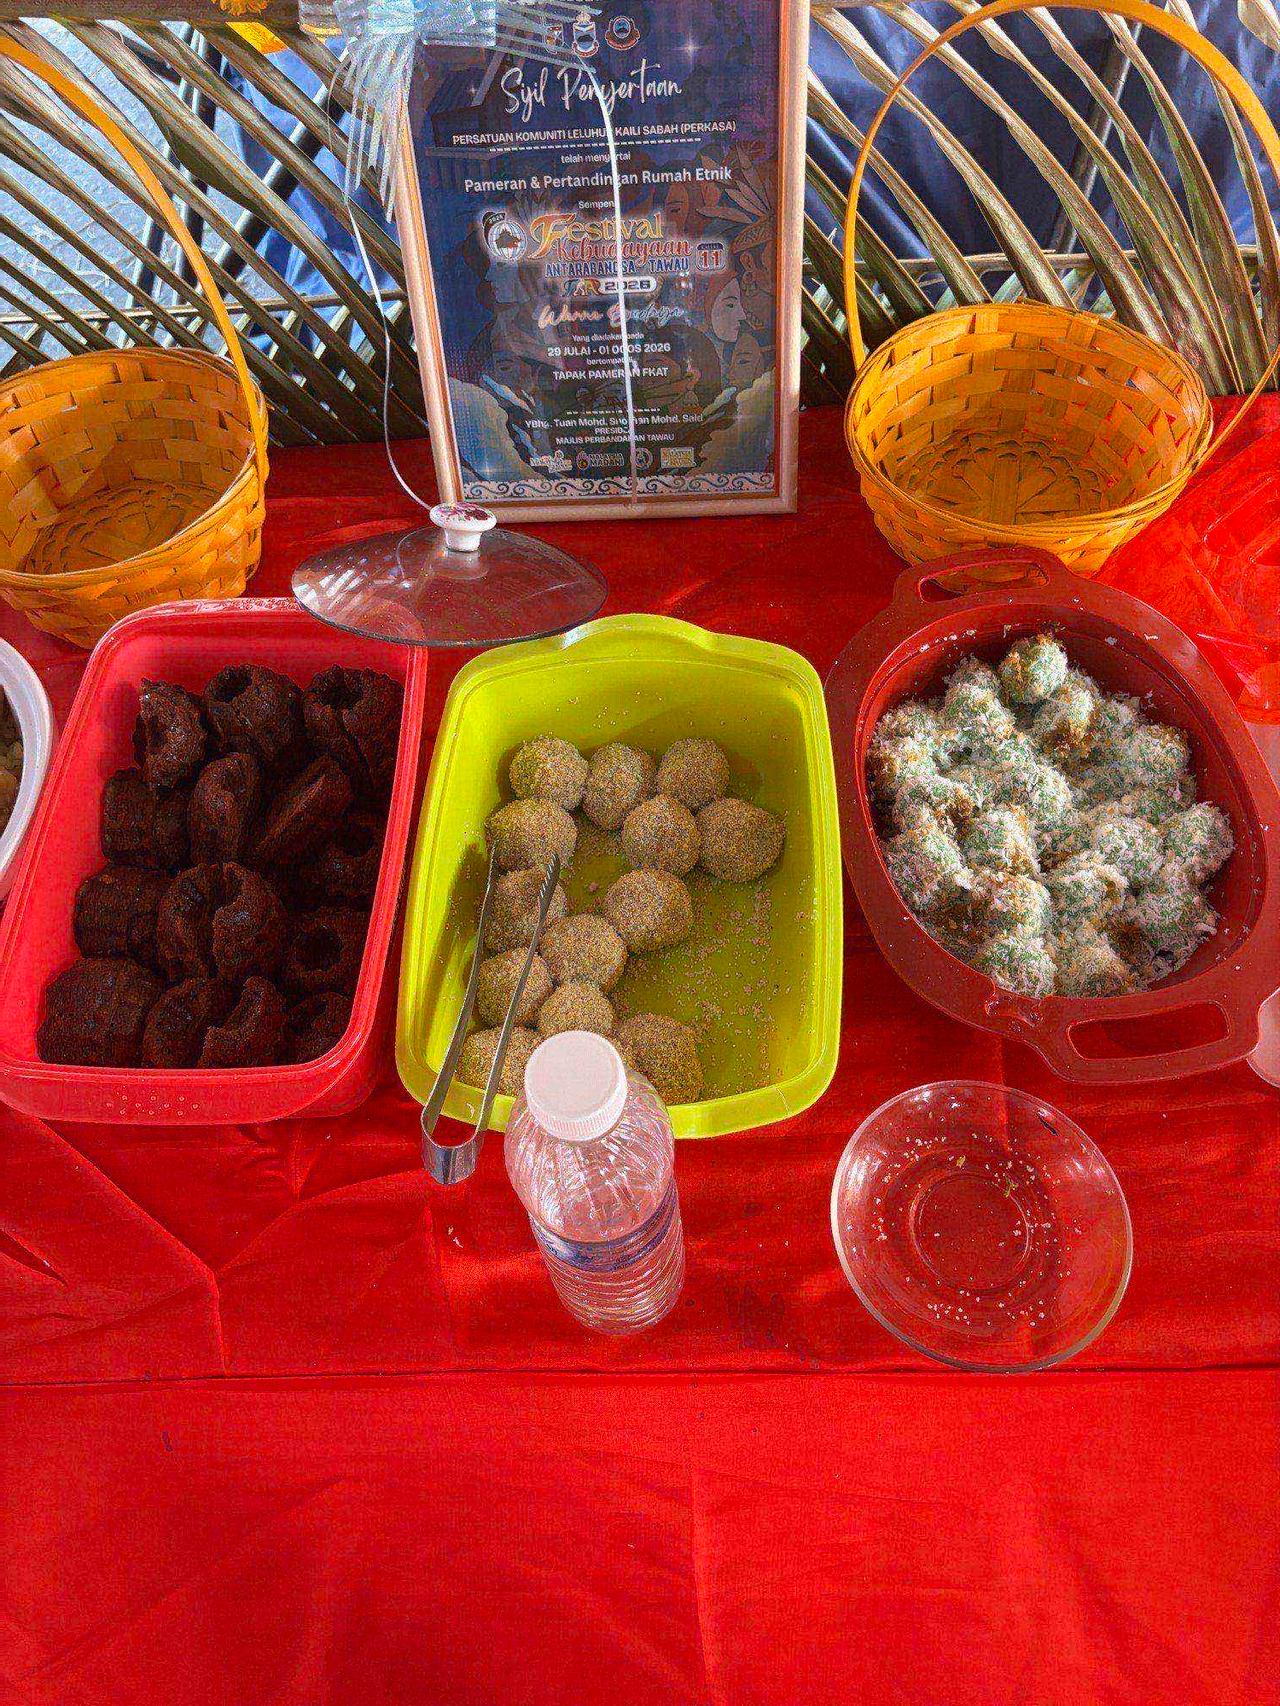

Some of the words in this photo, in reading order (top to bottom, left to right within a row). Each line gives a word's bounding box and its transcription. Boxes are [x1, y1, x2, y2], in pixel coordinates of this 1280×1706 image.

[500, 67, 549, 122] Sijil
[452, 132, 514, 146] PERSATUAN
[515, 130, 566, 142] KOMUNITI
[567, 127, 615, 140] LELUHU
[615, 125, 640, 137] KAILI
[642, 123, 678, 136] SABAH
[680, 120, 736, 135] (PERKASA)
[561, 154, 583, 164] telah
[585, 151, 631, 164] menyrtai
[465, 178, 527, 192] Pameran
[530, 176, 540, 189] &
[642, 168, 692, 183] Rumah
[695, 166, 732, 181] Etnik
[578, 200, 618, 210] Sempen
[648, 256, 690, 274] TAWAU
[571, 334, 590, 343] Yang
[547, 347, 561, 357] 29
[563, 346, 591, 357] JULAI
[644, 342, 671, 353] 2026
[553, 370, 587, 381] TAPAK
[642, 367, 669, 378] FKAT
[553, 418, 577, 428] Tuan
[578, 417, 608, 427] Mohd.
[651, 414, 680, 424] Mohd.
[682, 413, 703, 423] Said
[556, 436, 583, 445] MAJLIS
[584, 434, 646, 444] PERBANDAAN
[647, 433, 675, 443] TAWAU
